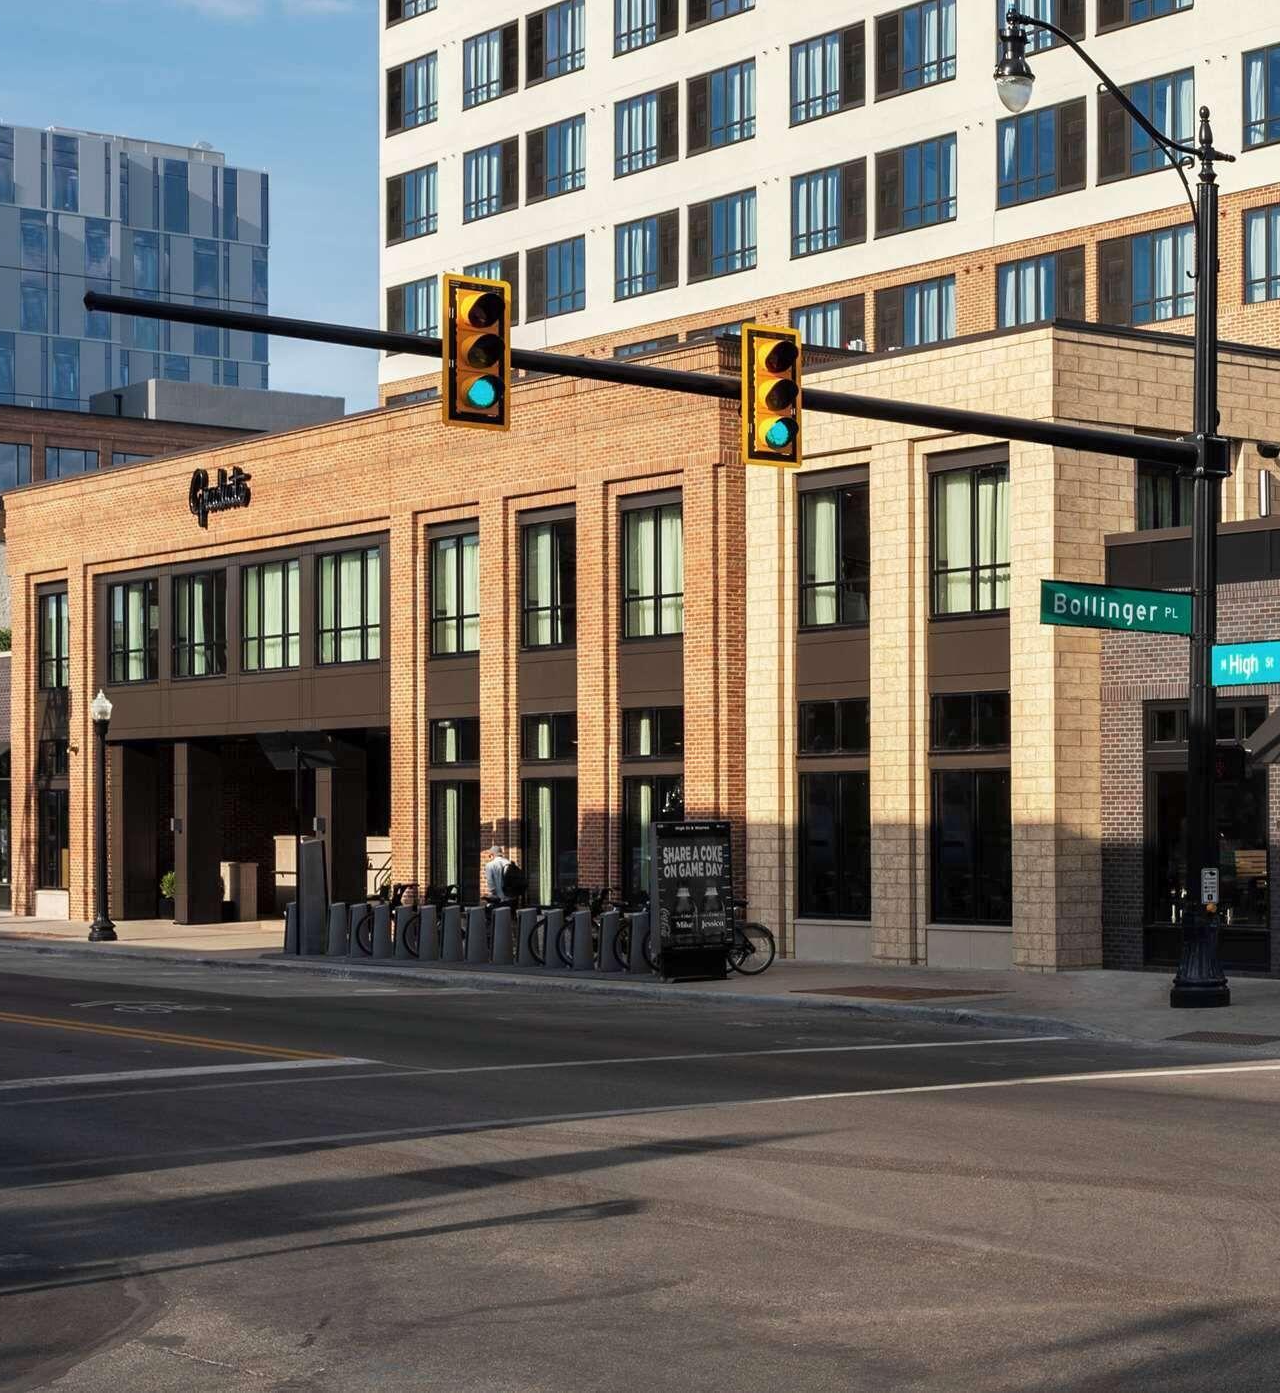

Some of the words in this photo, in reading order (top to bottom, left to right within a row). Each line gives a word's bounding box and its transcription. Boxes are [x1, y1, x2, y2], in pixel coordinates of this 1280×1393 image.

[1053, 592, 1158, 626] Bollinger
[1165, 607, 1178, 619] PL
[1229, 653, 1259, 680] High
[1265, 657, 1274, 669] St
[663, 846, 691, 864] SHARE
[692, 846, 699, 861] A
[700, 845, 723, 862] COKE
[664, 864, 677, 878] ON
[679, 862, 704, 878] GAME
[705, 862, 723, 877] DAY
[701, 920, 724, 929] Jessica
